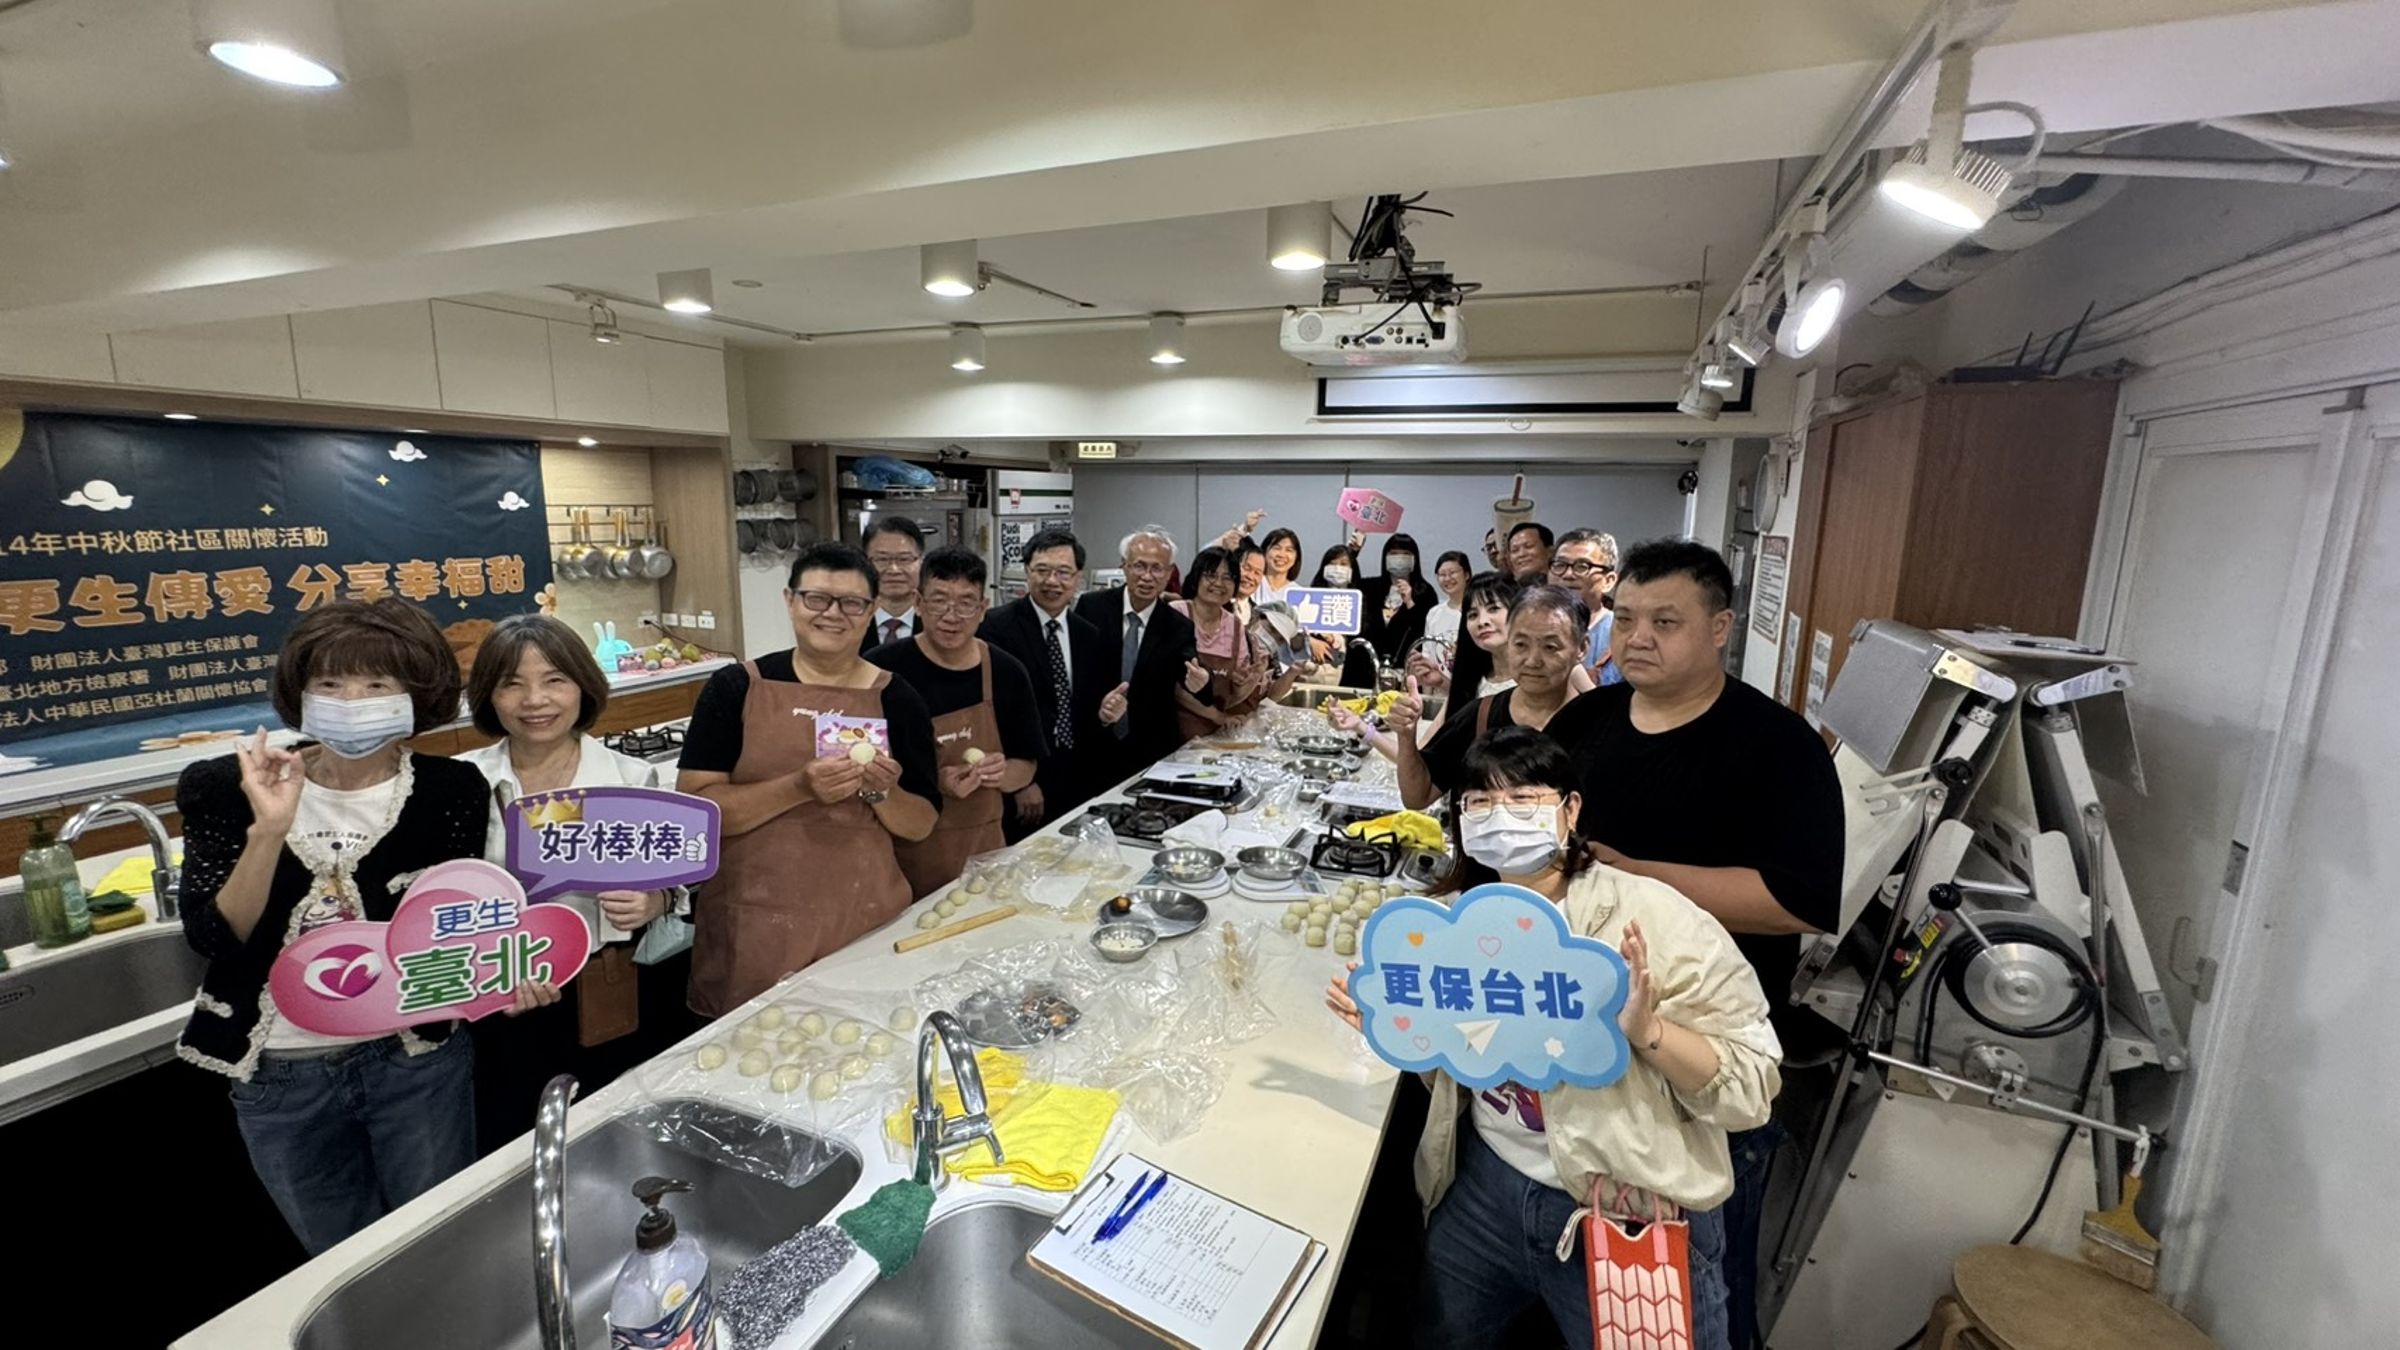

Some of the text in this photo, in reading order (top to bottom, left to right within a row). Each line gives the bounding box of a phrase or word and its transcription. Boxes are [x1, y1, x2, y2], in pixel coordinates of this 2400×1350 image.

[0, 554, 525, 635] 更生傳愛 分享幸福甜
[1321, 593, 1353, 627] 讚
[30, 634, 259, 672] 財團法人臺灣更生保護會
[540, 820, 684, 864] 好棒棒
[432, 897, 517, 938] 更生
[397, 932, 553, 1012] 臺北
[1380, 962, 1584, 1020] 更保台北
